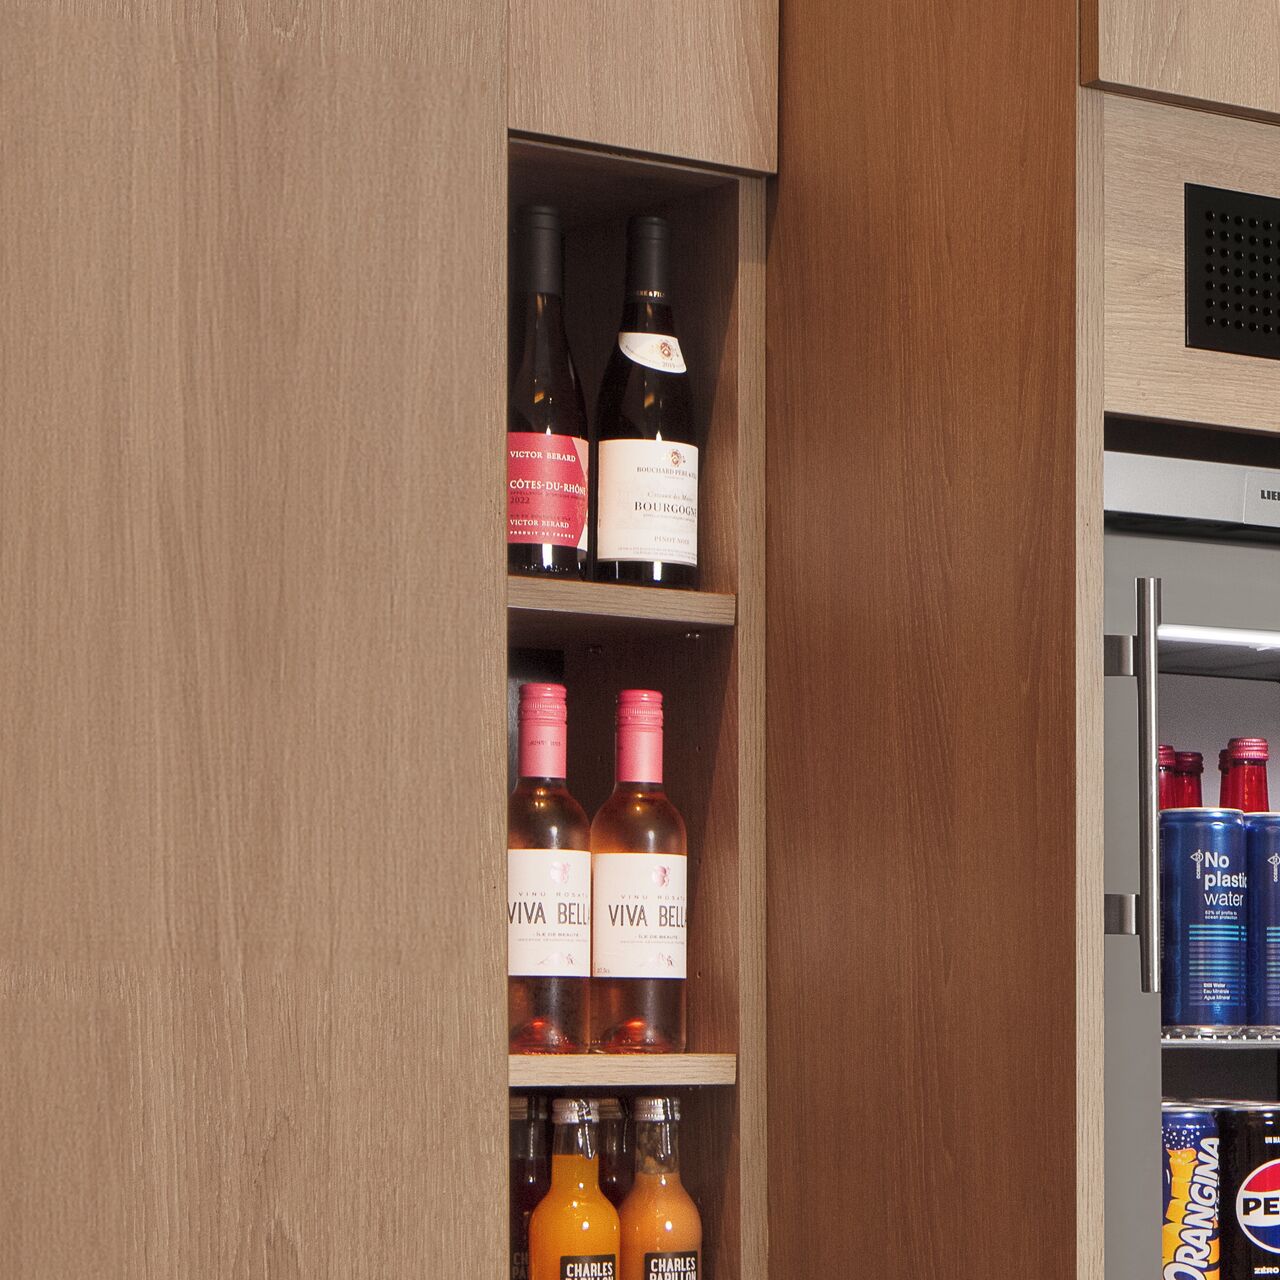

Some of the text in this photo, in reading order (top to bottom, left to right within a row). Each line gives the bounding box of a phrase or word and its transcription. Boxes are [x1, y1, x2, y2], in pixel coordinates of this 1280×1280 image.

[510, 451, 576, 462] VICTOR BERARD
[1205, 852, 1229, 868] No
[1204, 891, 1243, 906] water
[609, 905, 648, 927] VIVA
[566, 1262, 613, 1277] CHARLES
[650, 1257, 696, 1273] CHARLES
[1254, 1266, 1279, 1275] ZÉRO
